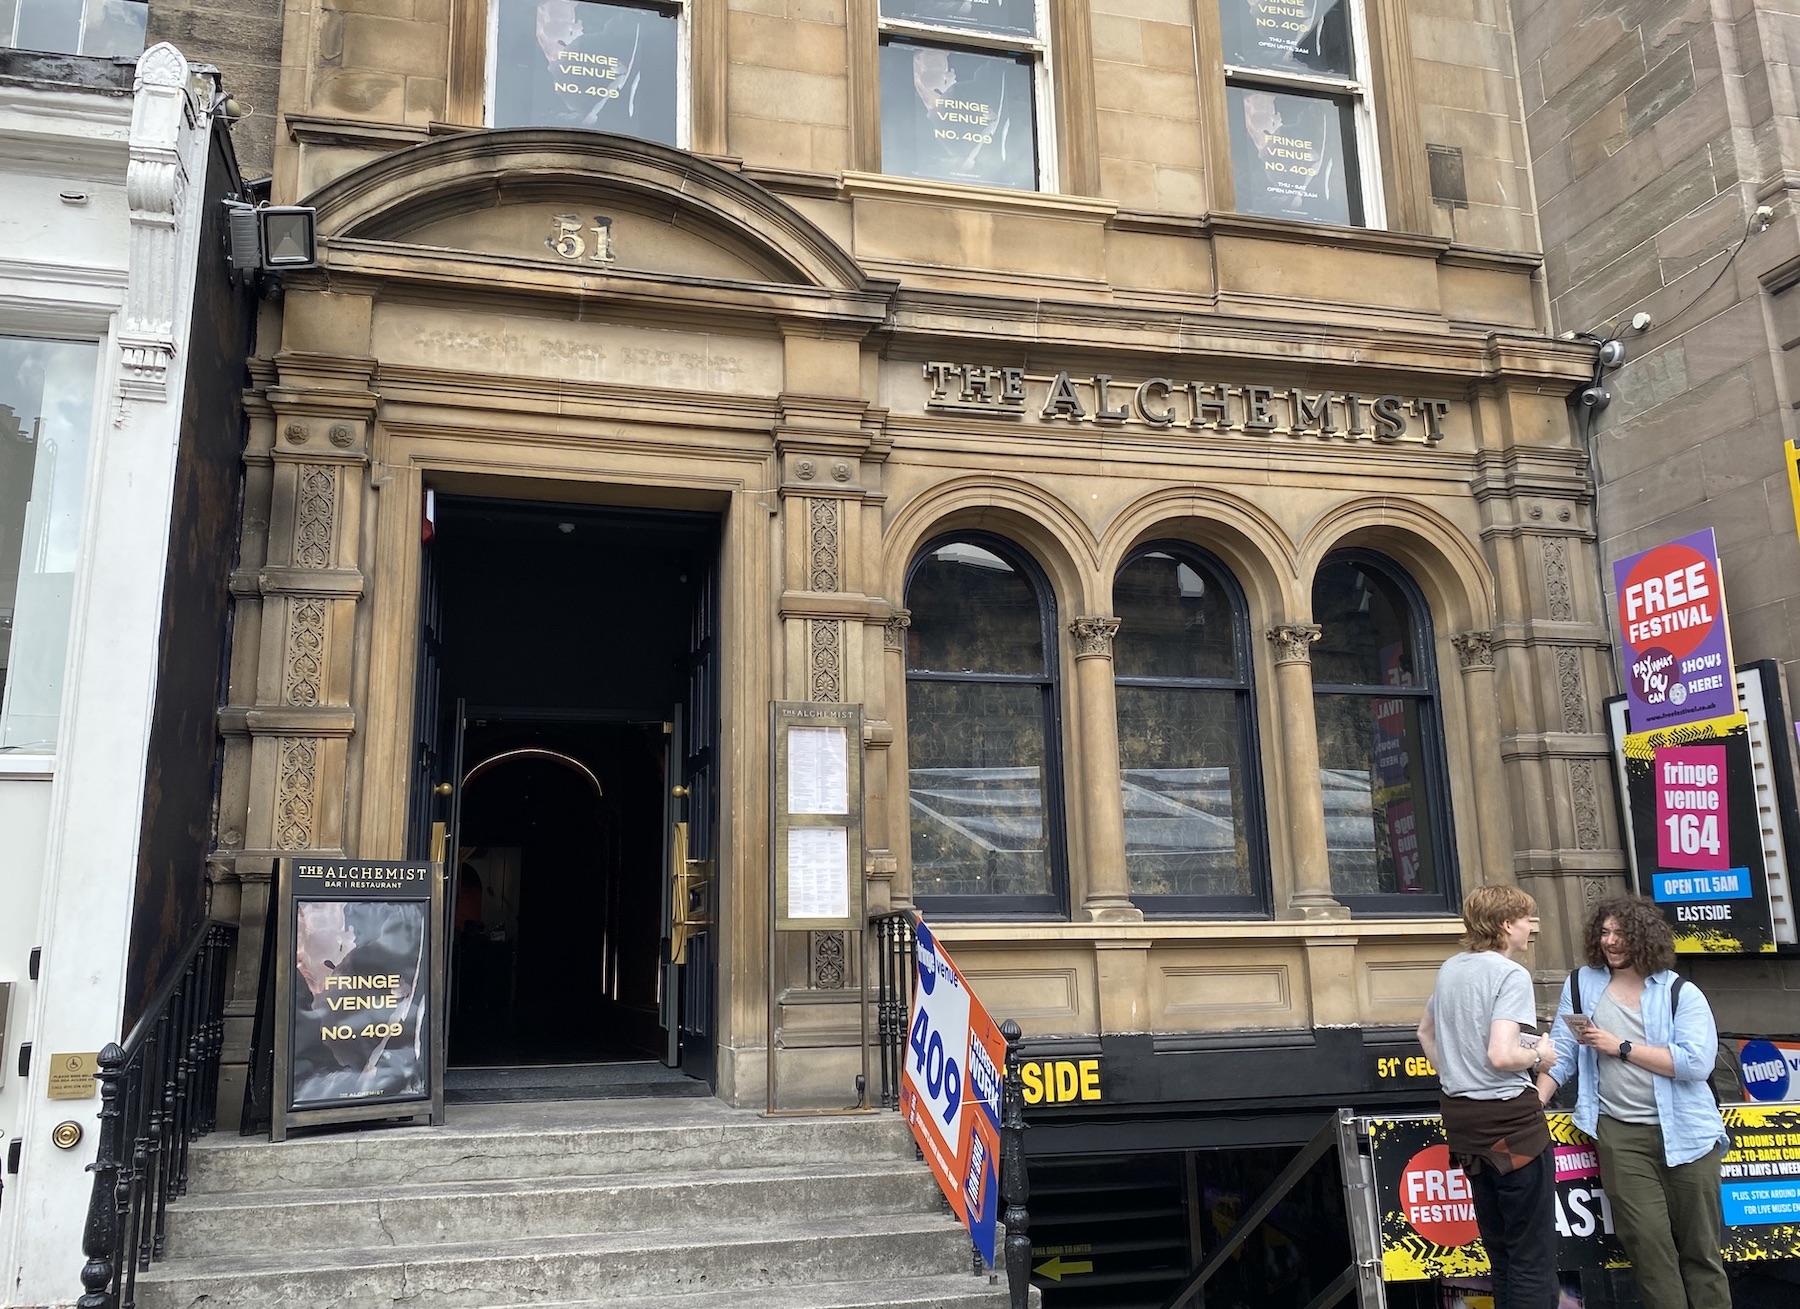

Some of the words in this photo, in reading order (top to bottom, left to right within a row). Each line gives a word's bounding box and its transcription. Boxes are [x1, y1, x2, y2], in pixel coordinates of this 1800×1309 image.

[1258, 4, 1304, 17] VENUE
[1256, 18, 1278, 28] NO.
[1281, 21, 1308, 32] 409
[558, 51, 618, 67] FRINGE
[559, 65, 616, 80] VENUE
[554, 82, 581, 94] NO.
[585, 85, 620, 99] 409
[935, 99, 989, 114] FRINGE
[937, 112, 989, 126] VENUE
[934, 129, 959, 140] NO.
[962, 132, 992, 144] 409
[1265, 135, 1312, 150] FRINGE
[1267, 147, 1313, 162] VENUE
[1265, 161, 1287, 173] NO.
[1290, 165, 1317, 177] 409
[551, 214, 616, 263] 51
[923, 361, 1025, 403] THE
[1039, 370, 1450, 446] ALCHEMIST
[1625, 561, 1710, 621] FREE
[1628, 603, 1713, 644] FESTIVAL
[1632, 655, 1653, 678] PAY
[1651, 654, 1673, 672] WHAT
[1682, 653, 1722, 674] SHOWS
[1641, 672, 1668, 693] YOU
[1688, 674, 1723, 694] HERE!
[1648, 692, 1666, 704] CAN
[797, 710, 853, 718] ALCHEMIST
[1664, 761, 1719, 787] fringe
[1664, 789, 1719, 810] venue
[1665, 814, 1721, 855] 164
[299, 865, 323, 875] THE
[325, 867, 427, 880] ALCHEMIST
[1664, 879, 1693, 895] OPEN
[1695, 877, 1711, 893] TIL
[1713, 875, 1739, 892] 5AM
[1677, 905, 1732, 922] EASTSIDE
[936, 960, 959, 988] venue
[324, 975, 400, 991] FRINGE
[327, 995, 398, 1011] VENUE
[321, 1025, 357, 1041] NO.
[361, 1023, 403, 1038] 409
[970, 1025, 1000, 1088] THIRSTY
[911, 1005, 961, 1126] 409
[1742, 1059, 1786, 1083] fringe
[969, 1045, 999, 1119] WORK
[1735, 1136, 1743, 1148] 3
[1743, 1134, 1775, 1147] ROOMS
[1775, 1134, 1787, 1146] OF
[1555, 1151, 1598, 1172] FRINGE
[1721, 1149, 1782, 1163] ACK-TO-BACK
[1720, 1165, 1743, 1178] OPEN
[1743, 1164, 1748, 1177] 7
[1748, 1163, 1771, 1176] DAYS
[1772, 1163, 1779, 1175] A
[1751, 1190, 1770, 1200] STICK
[1771, 1188, 1796, 1198] AROUND
[1744, 1206, 1757, 1215] FOR
[1757, 1205, 1771, 1214] LIVE
[1771, 1204, 1792, 1213] MUSIC
[1064, 1245, 1072, 1253] TO
